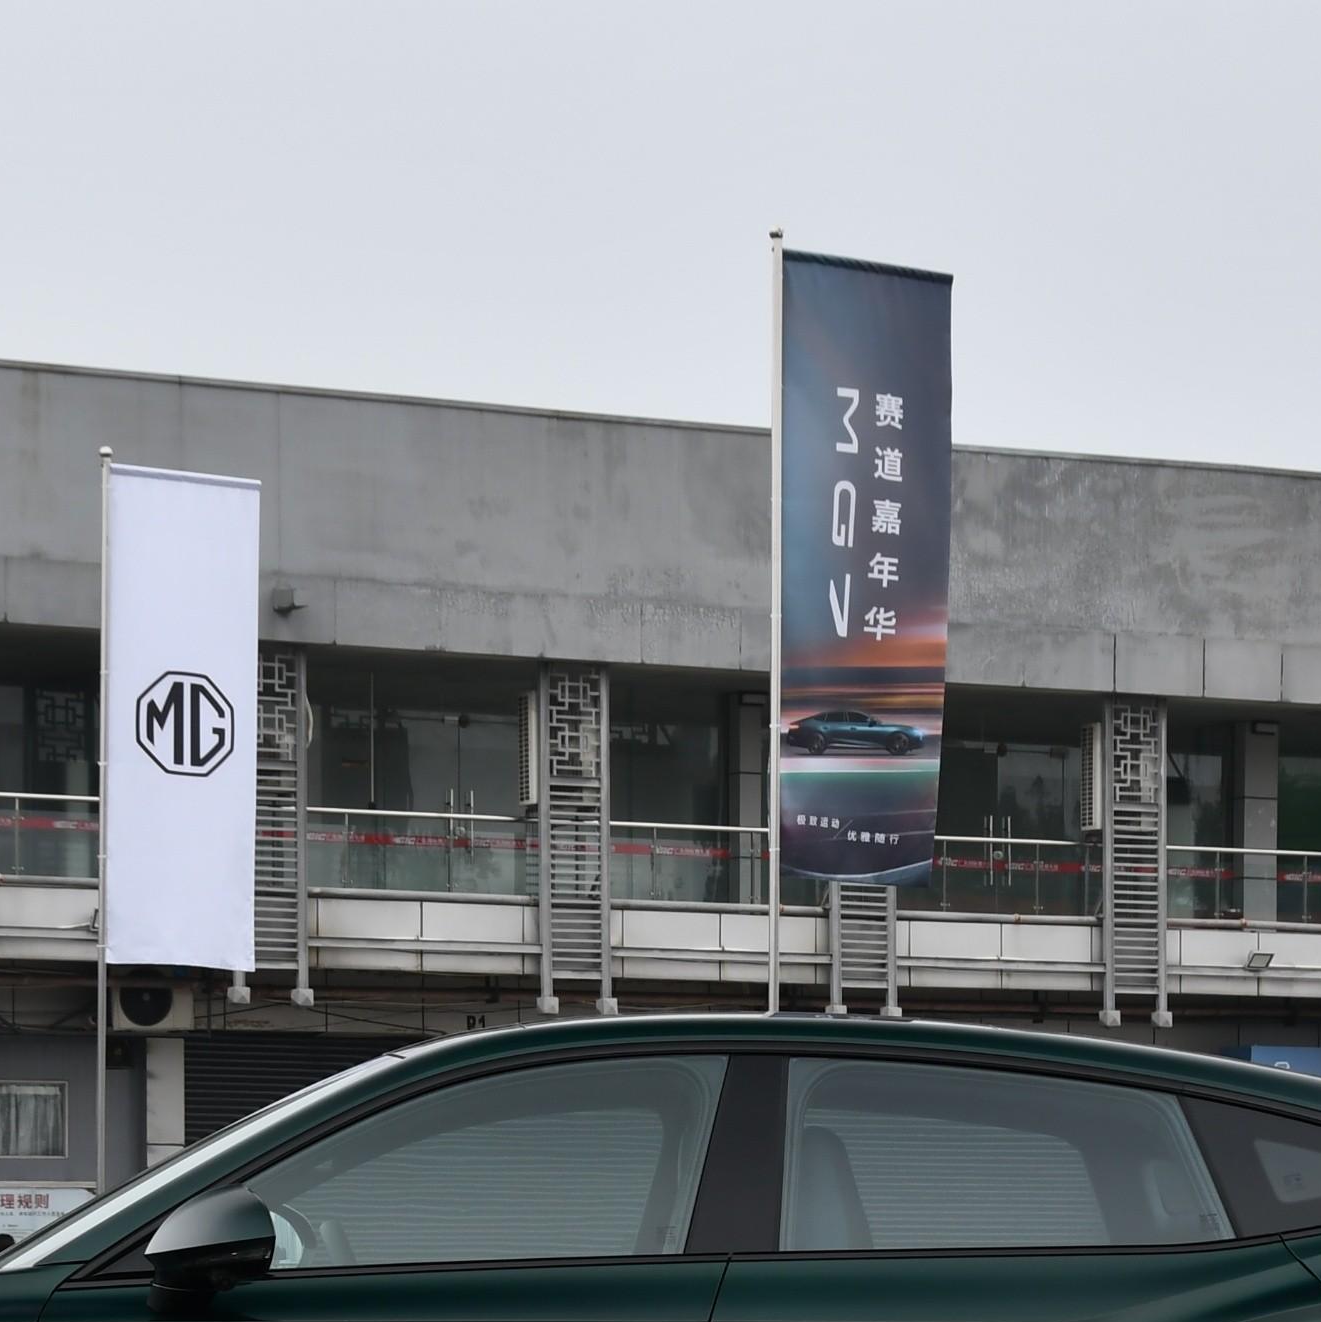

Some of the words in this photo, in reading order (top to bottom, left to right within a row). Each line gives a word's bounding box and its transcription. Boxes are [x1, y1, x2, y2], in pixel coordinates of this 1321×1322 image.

[864, 393, 904, 641] 赛道嘉年华
[146, 681, 226, 767] MG
[797, 814, 840, 829] 极致运动
[847, 830, 900, 845] 优雅随行
